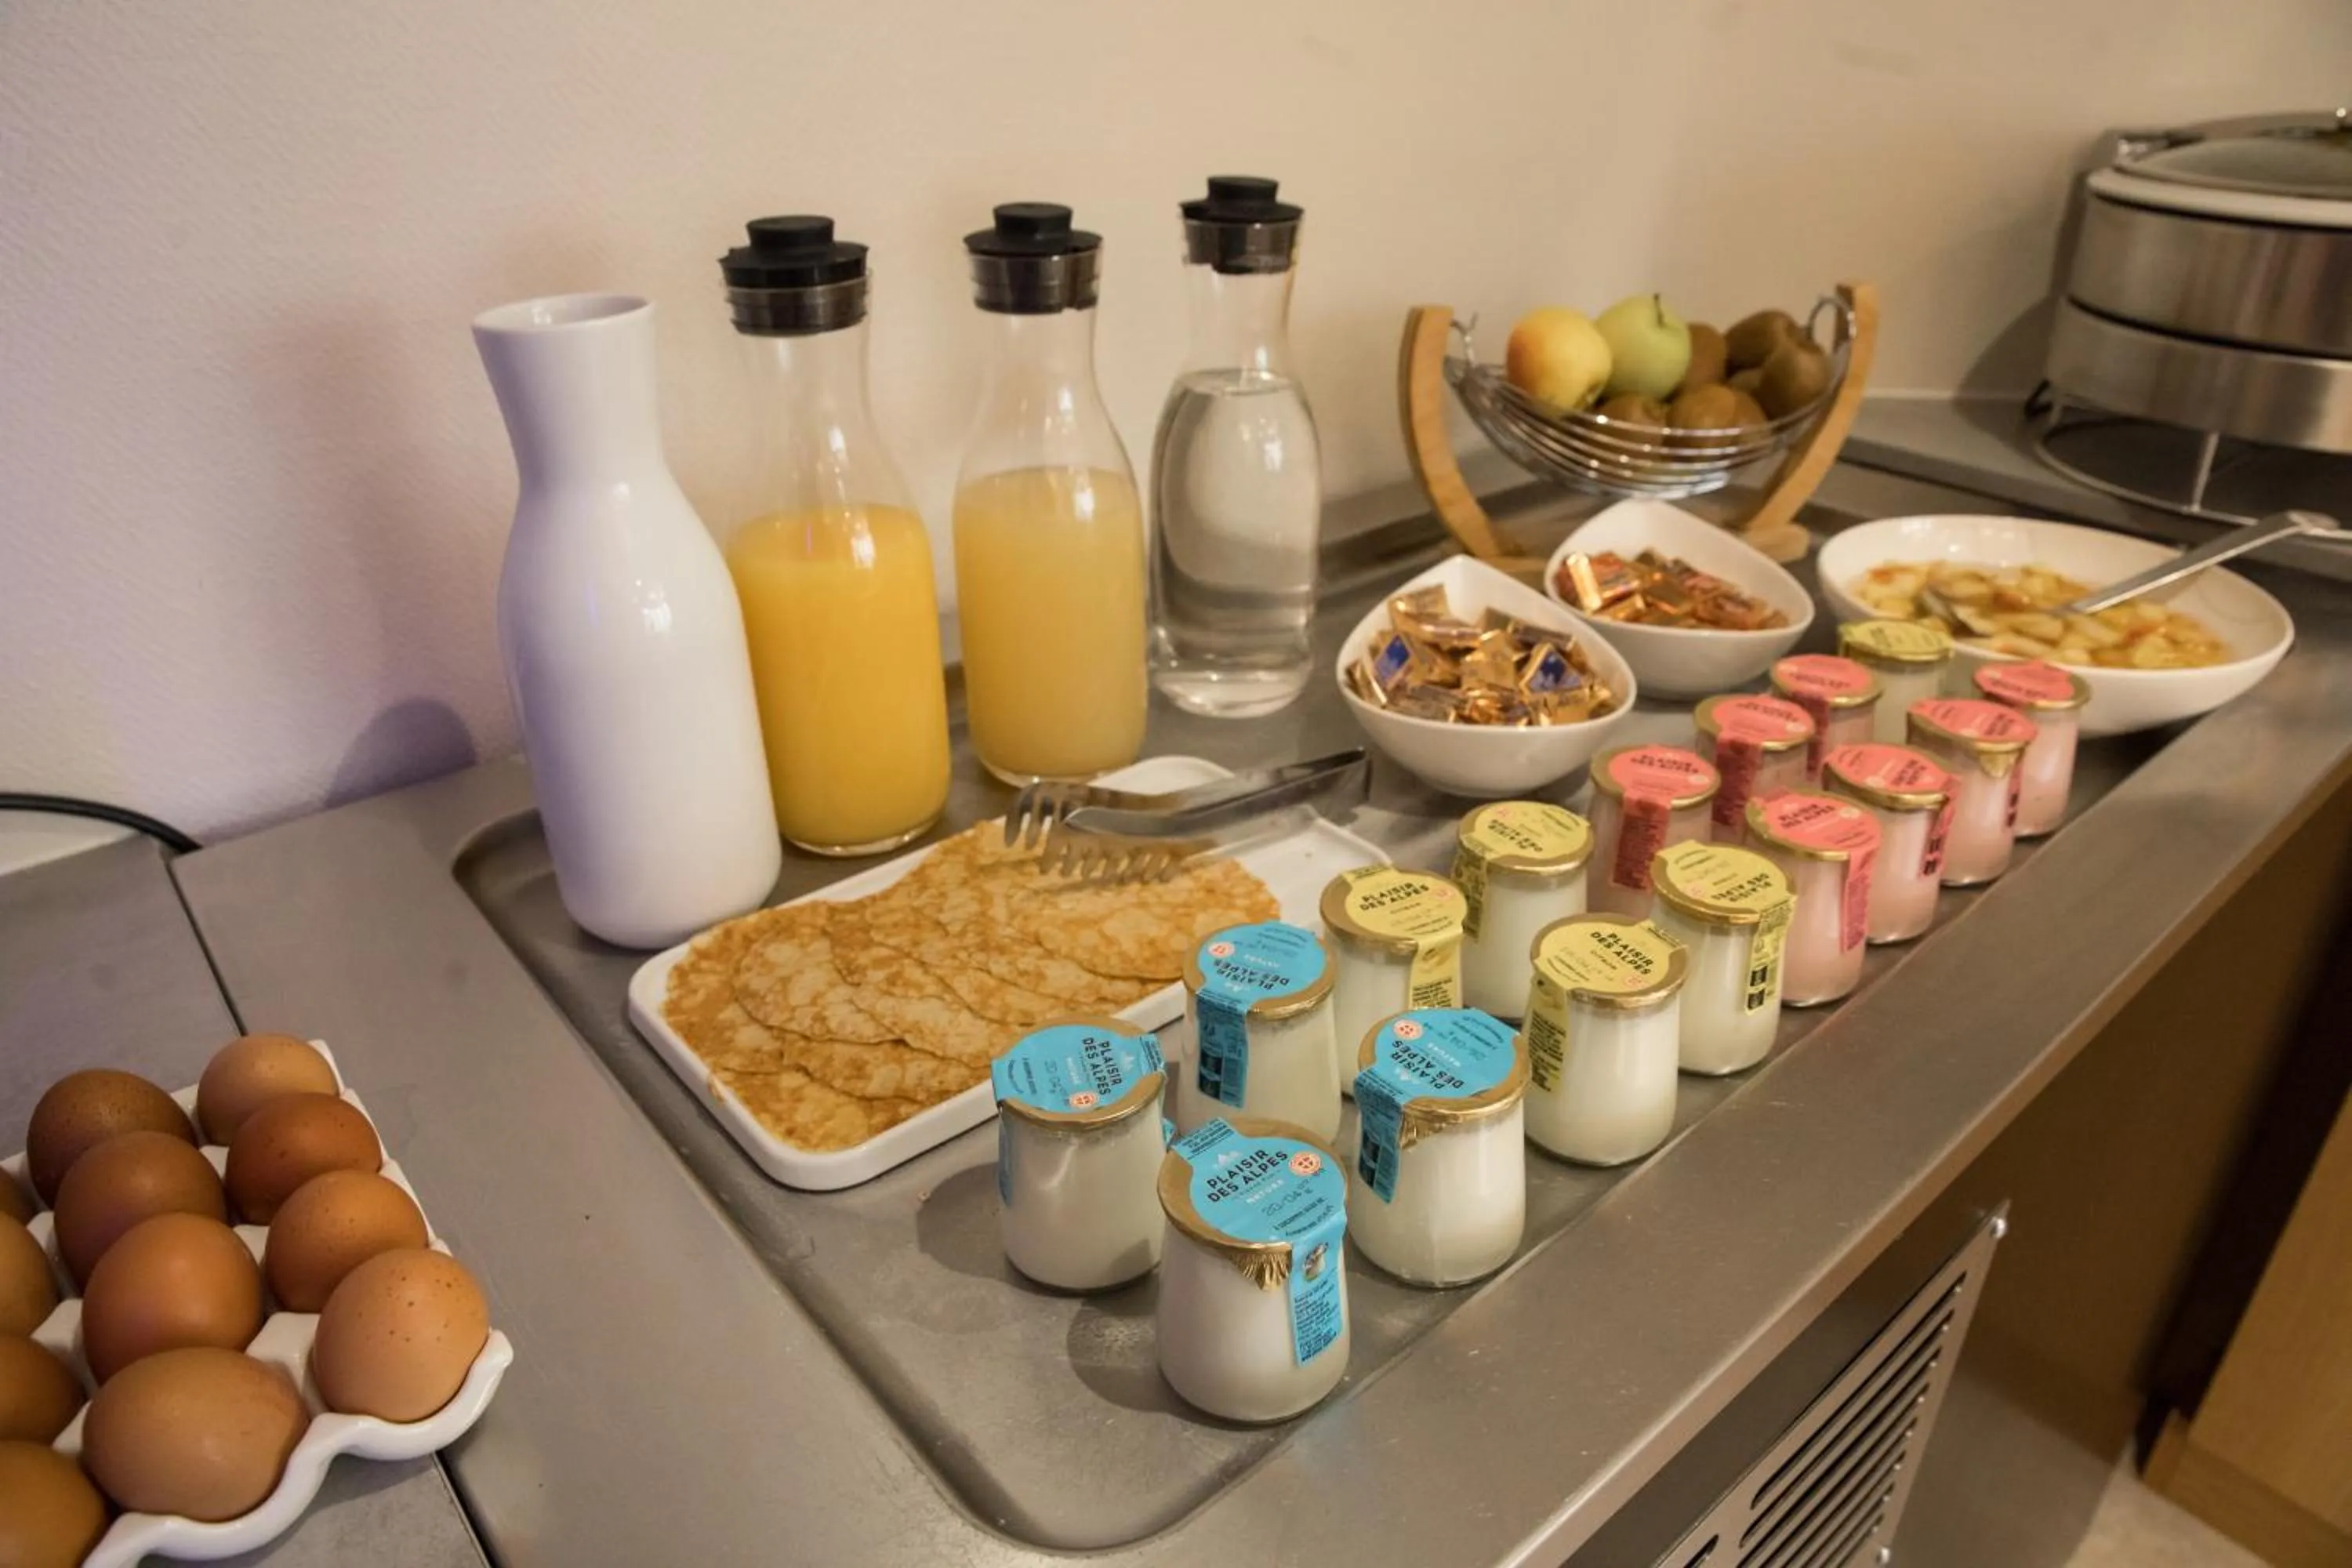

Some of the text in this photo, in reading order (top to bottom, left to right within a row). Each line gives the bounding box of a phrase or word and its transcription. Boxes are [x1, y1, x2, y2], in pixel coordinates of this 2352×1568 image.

[1359, 884, 1430, 911] DES ALPES
[1362, 882, 1414, 902] PLAISIR
[1590, 931, 1614, 949] DES
[1613, 951, 1651, 975] ALPES
[1607, 932, 1653, 967] PLAISIR
[1082, 1036, 1112, 1096] DES ALPES
[1098, 1040, 1123, 1087] PLAISIR
[1391, 1052, 1445, 1090] PLAISIR
[1392, 1040, 1436, 1069] ALPES
[1436, 1070, 1465, 1089] DES
[1207, 1149, 1269, 1190] PLAISIR
[1207, 1183, 1239, 1203] DES
[1243, 1149, 1289, 1186] ALPES
